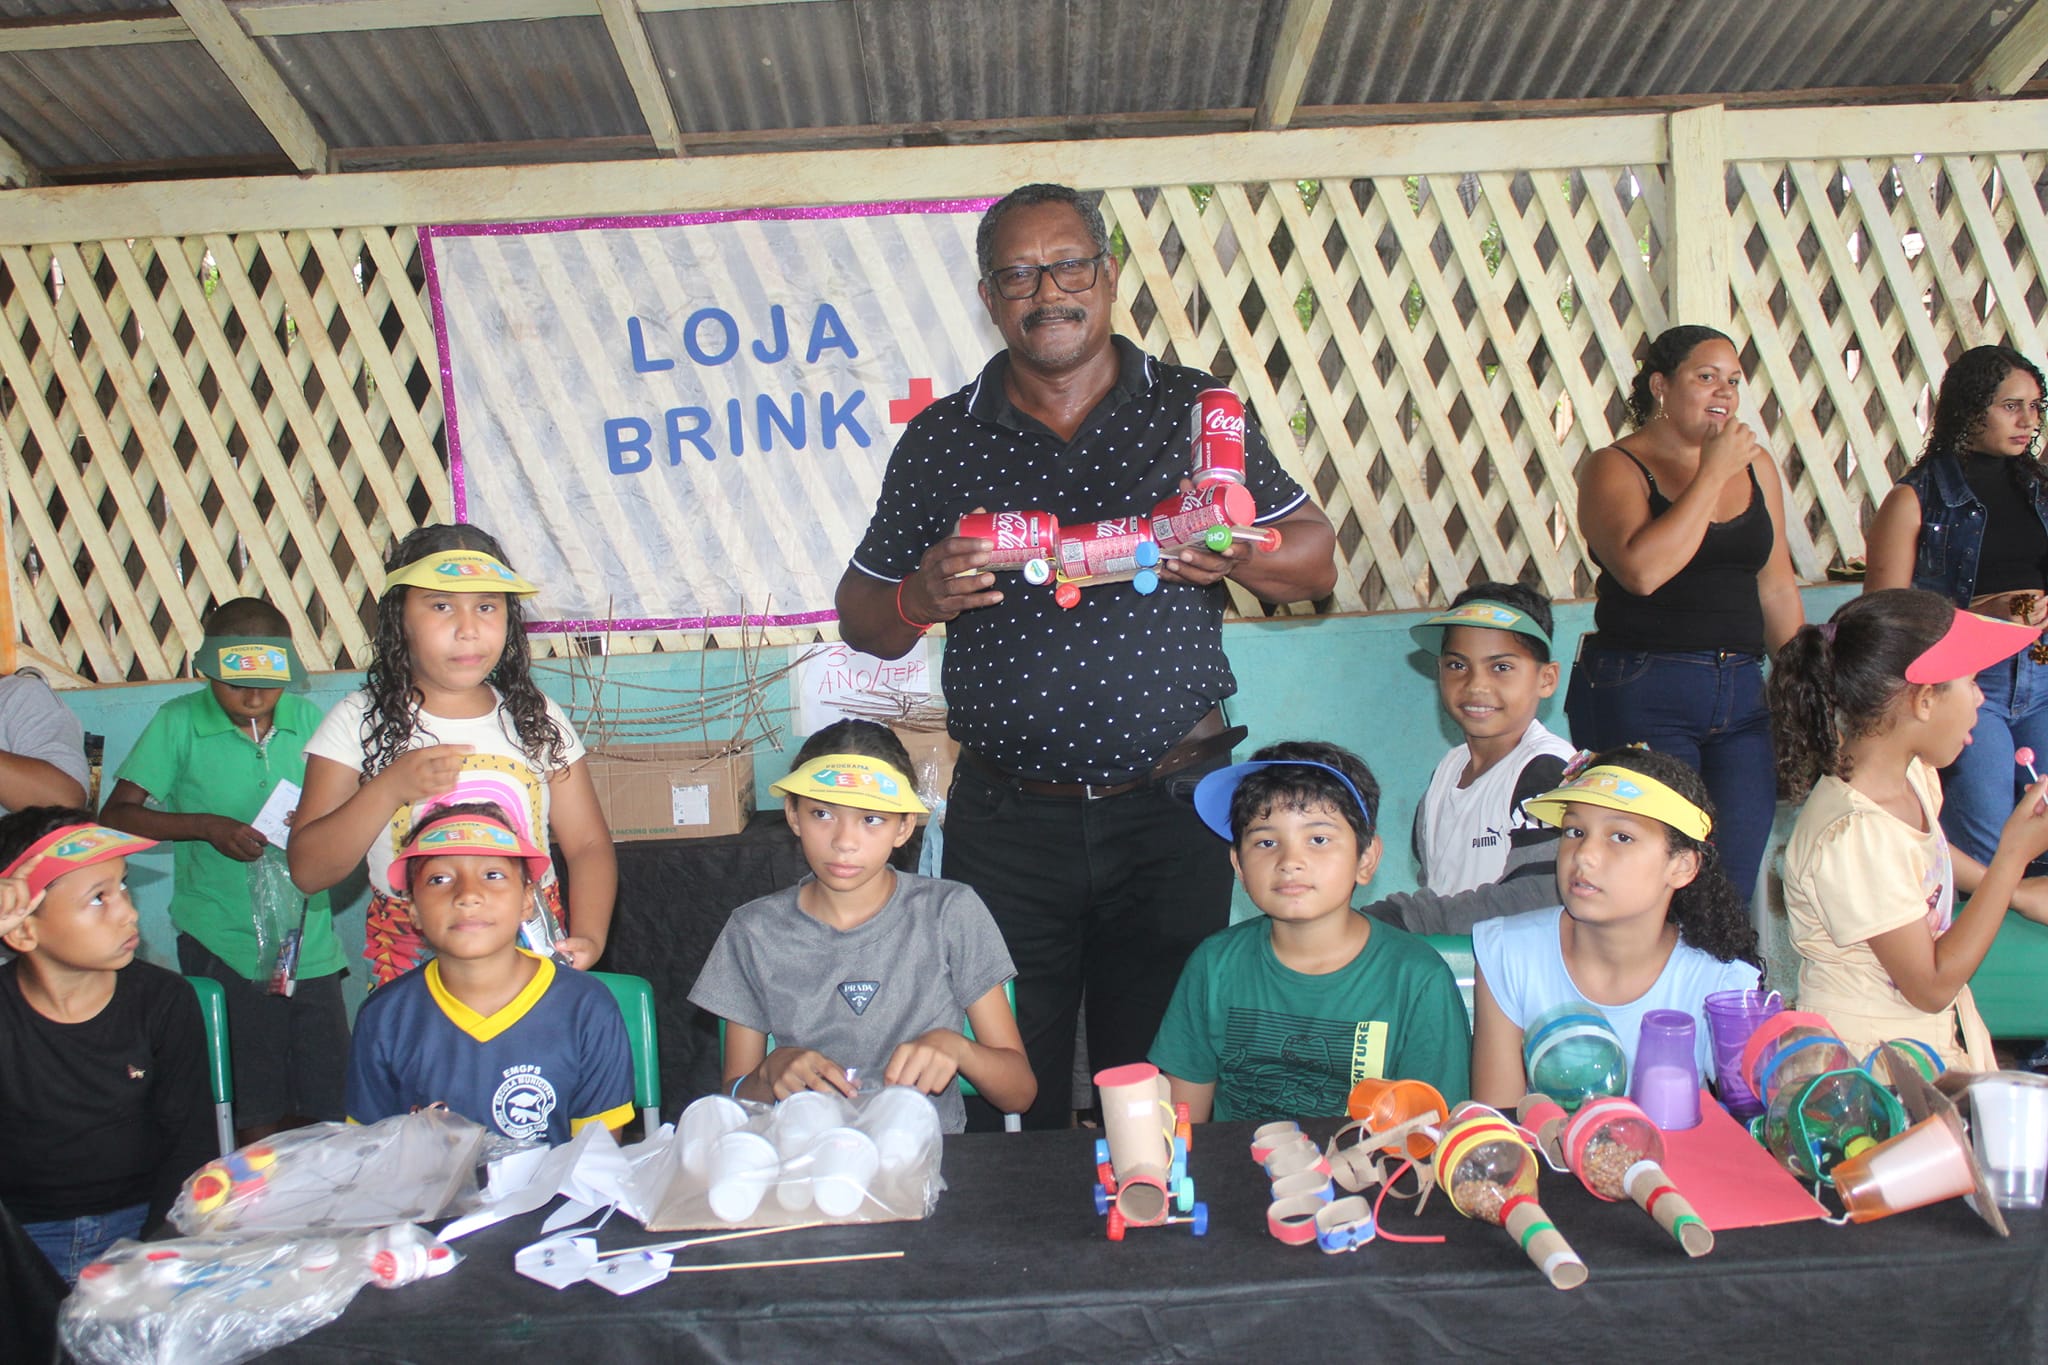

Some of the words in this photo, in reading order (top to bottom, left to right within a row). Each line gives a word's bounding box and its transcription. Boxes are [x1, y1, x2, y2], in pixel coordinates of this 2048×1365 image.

[627, 303, 859, 373] LOJA
[1206, 408, 1245, 431] Coca
[604, 390, 871, 475] BRINK
[998, 513, 1028, 549] Cola
[817, 770, 896, 789] JEPP
[1472, 836, 1497, 848] PUMA
[844, 984, 873, 992] PRADA
[1353, 1021, 1370, 1088] ENTURE
[502, 1064, 541, 1078] EMGPS
